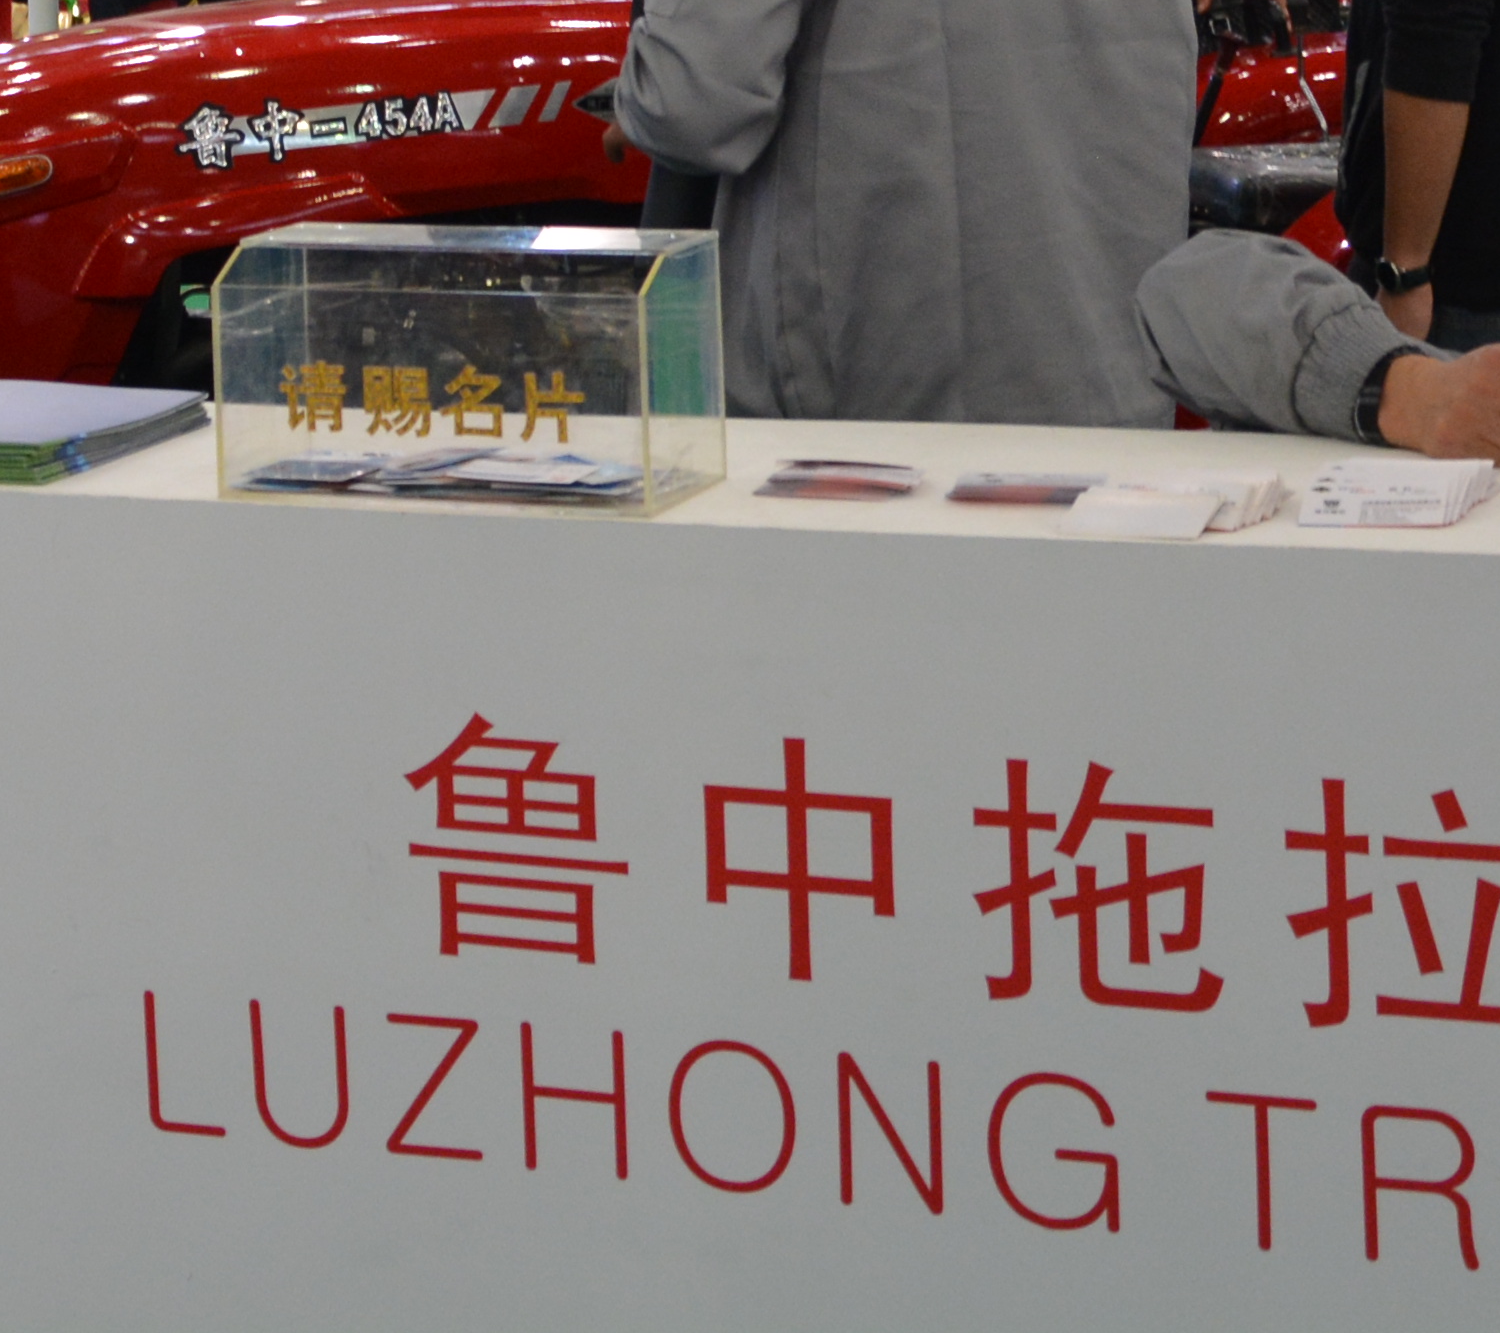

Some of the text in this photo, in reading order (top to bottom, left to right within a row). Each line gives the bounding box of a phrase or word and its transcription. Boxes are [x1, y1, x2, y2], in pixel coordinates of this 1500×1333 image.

[279, 359, 587, 444] 请赐名片
[144, 991, 1120, 1232] LUZHONG
